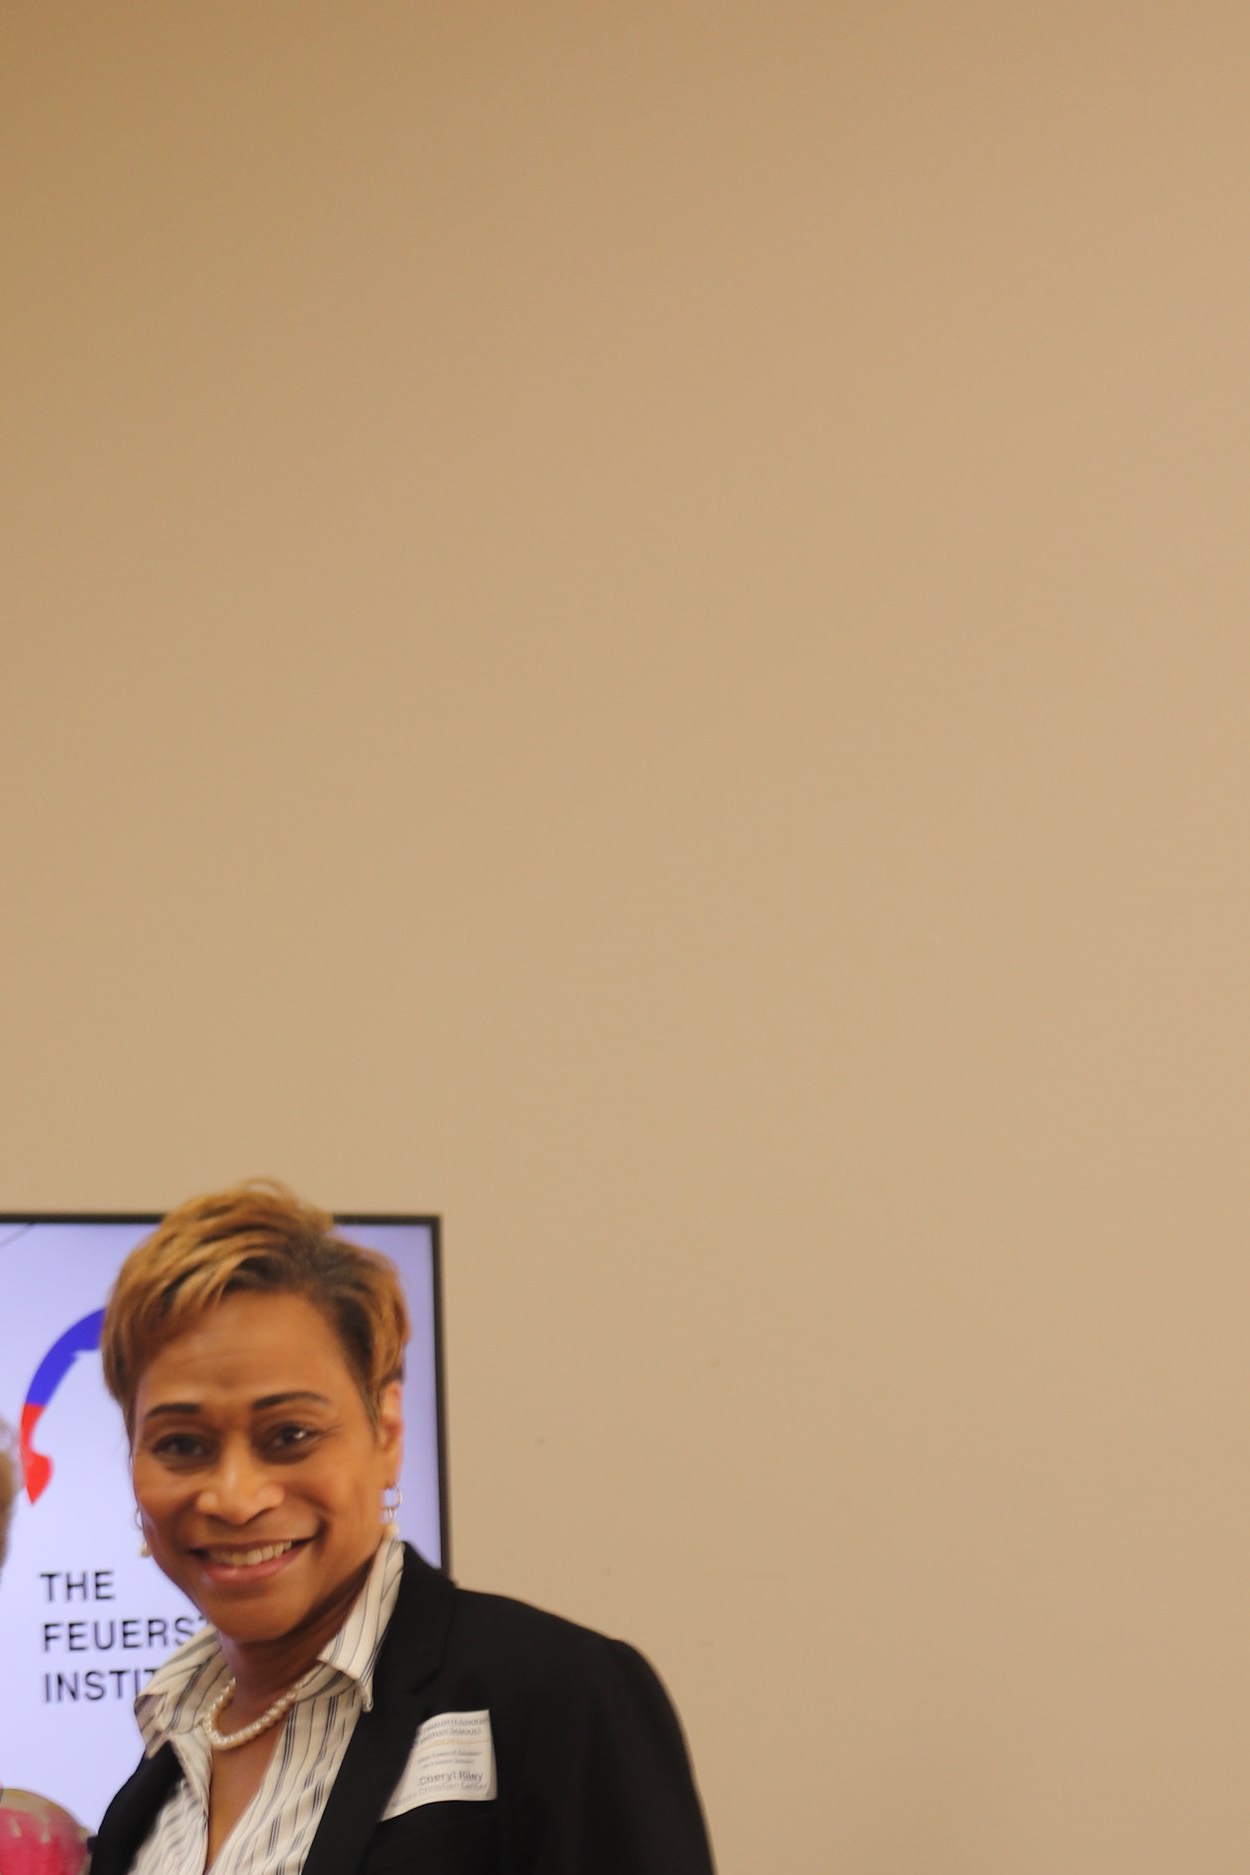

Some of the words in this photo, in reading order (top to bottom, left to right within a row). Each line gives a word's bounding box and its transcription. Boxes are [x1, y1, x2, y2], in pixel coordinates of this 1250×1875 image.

[39, 1570, 115, 1602] THE
[43, 1614, 207, 1653] FEUERS
[459, 1769, 484, 1784] Riley
